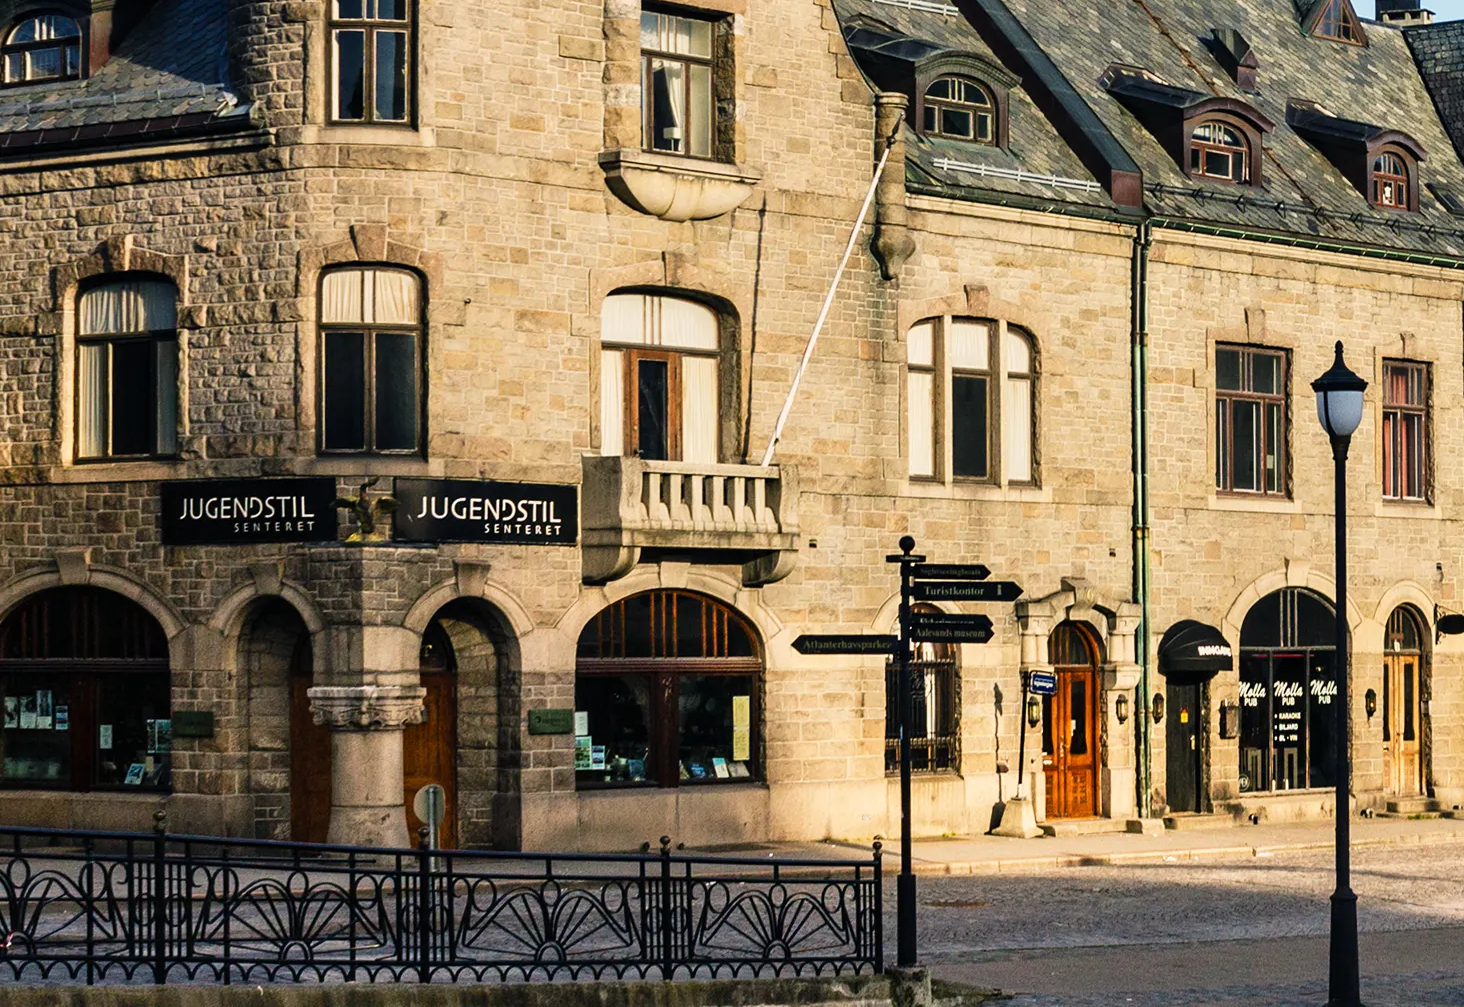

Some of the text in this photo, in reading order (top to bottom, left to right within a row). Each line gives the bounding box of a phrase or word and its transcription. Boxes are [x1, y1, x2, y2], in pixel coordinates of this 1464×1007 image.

[179, 496, 315, 520] JUGENDSTIL
[416, 496, 562, 523] JUGENDSTIL
[234, 521, 315, 533] SENTERET
[484, 523, 562, 536] SENTERET
[924, 585, 985, 596] Turistkontor
[1239, 680, 1266, 698] Molla
[1273, 680, 1304, 697] Molla
[1309, 679, 1338, 695] Molla
[1244, 697, 1258, 707] PUB
[1282, 697, 1296, 706] PUB
[1318, 695, 1332, 705] PUB
